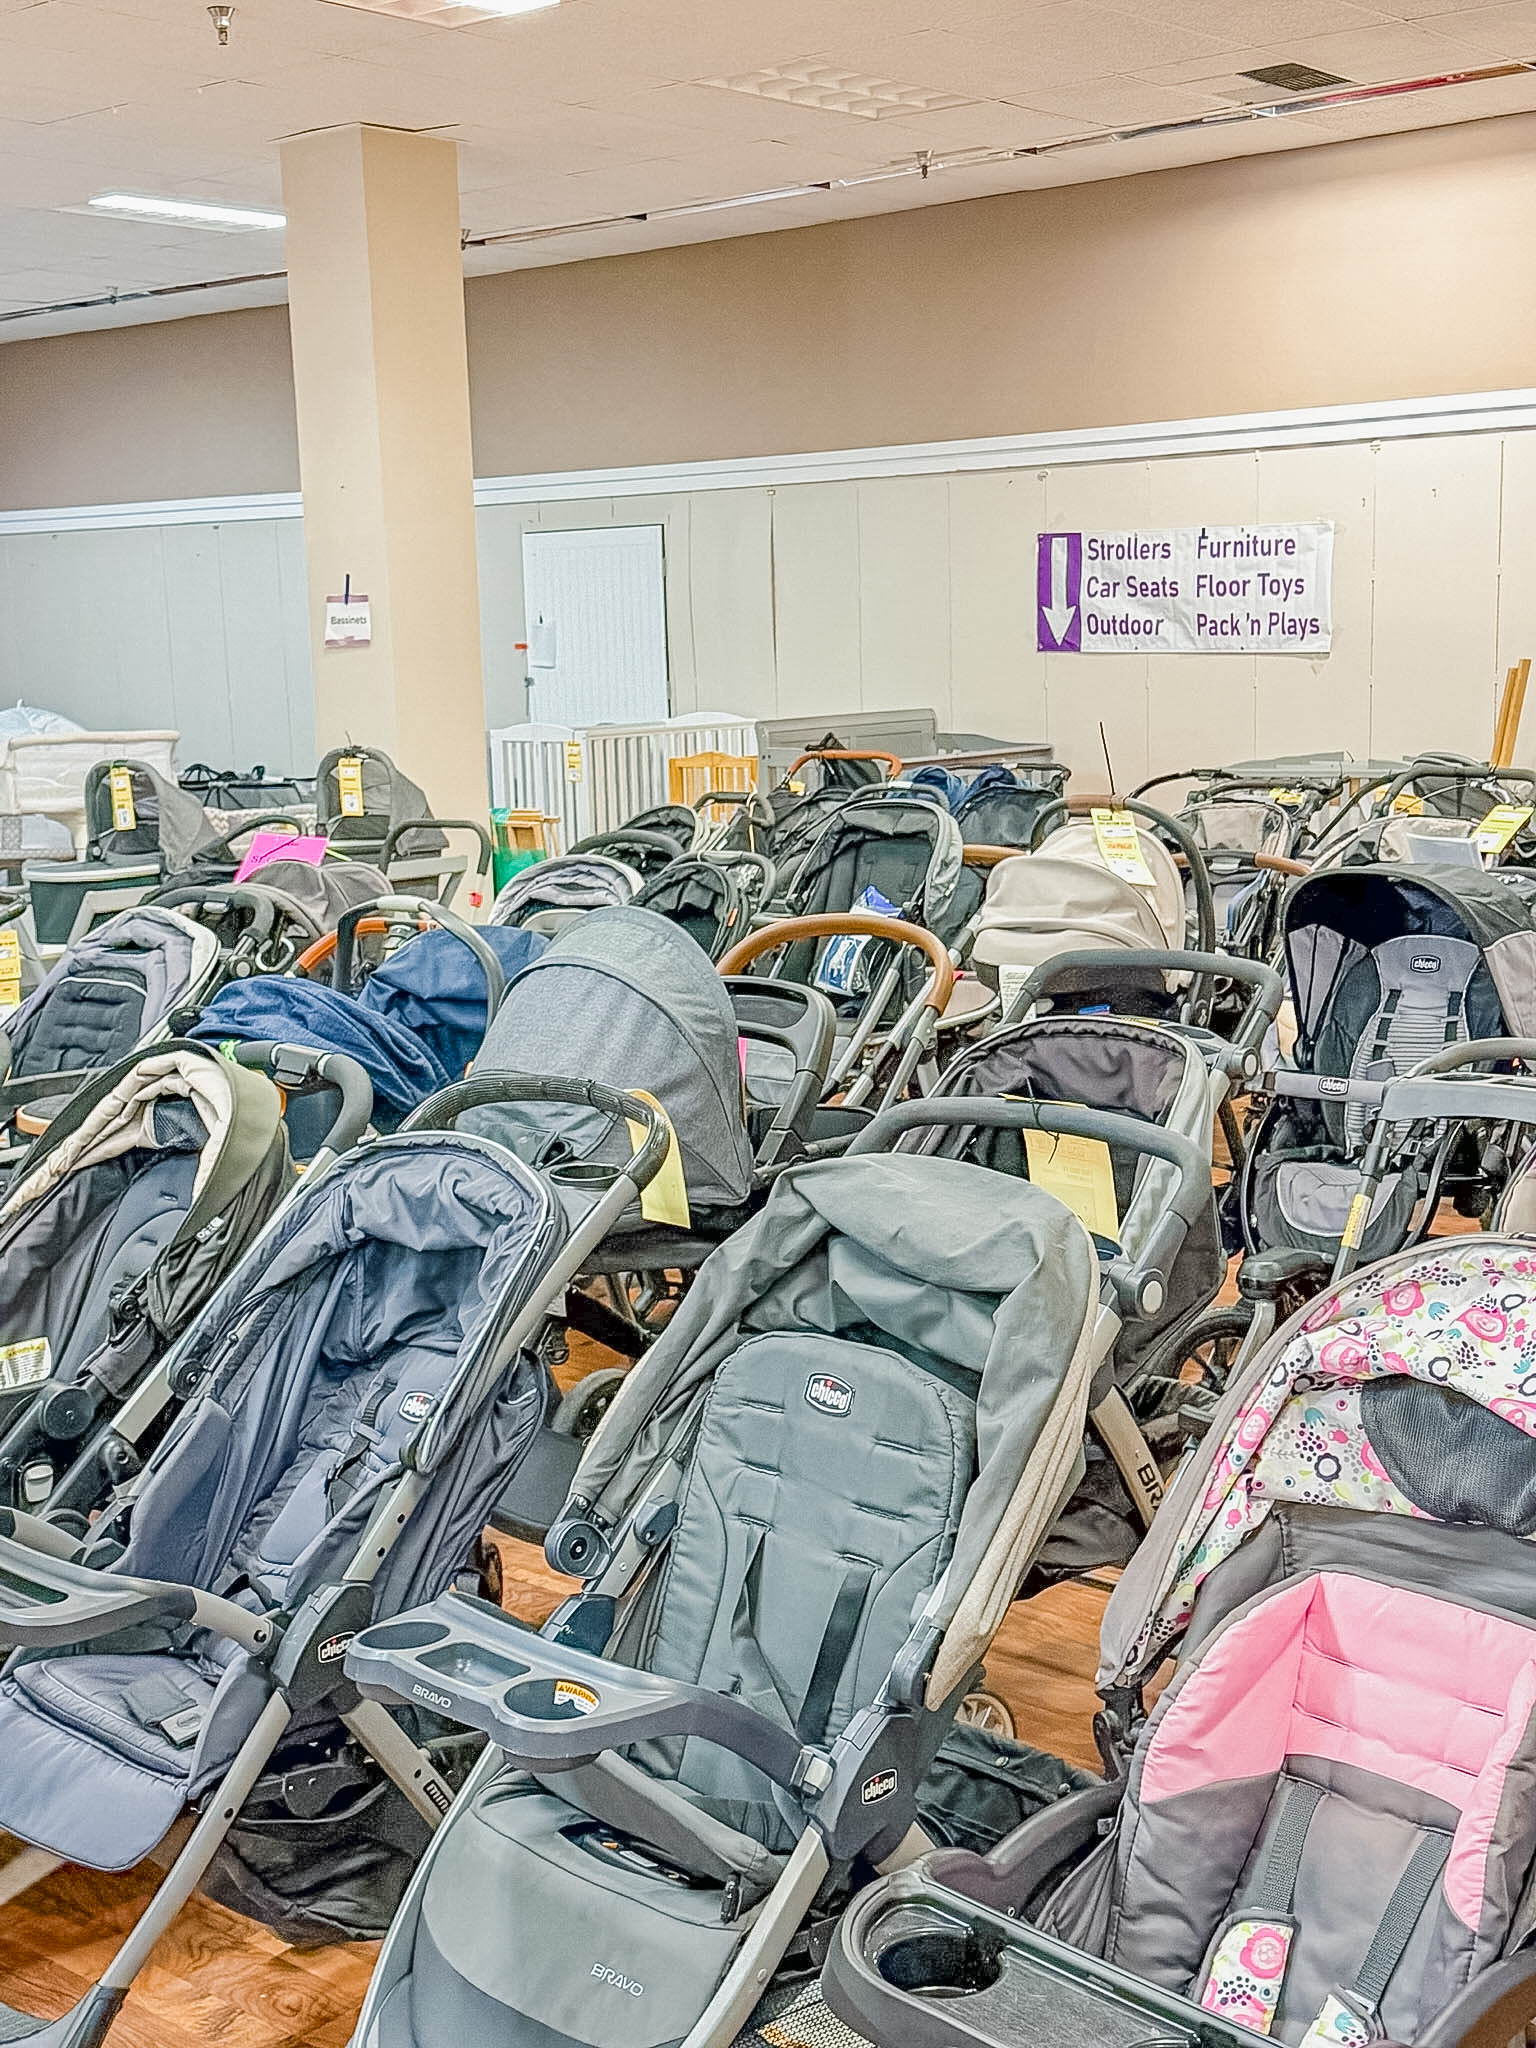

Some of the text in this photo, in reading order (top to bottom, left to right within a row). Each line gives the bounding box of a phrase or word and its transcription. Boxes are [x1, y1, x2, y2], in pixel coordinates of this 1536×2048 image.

[1087, 537, 1171, 561] Strollers
[1197, 533, 1297, 559] Furniture
[1087, 576, 1179, 598] Car Seats
[1197, 573, 1305, 602] Floor Toys
[1087, 613, 1164, 636] Outdoor
[1197, 613, 1240, 637] Pack
[1268, 612, 1320, 641] Plays
[810, 1379, 849, 1409] chicco
[1137, 1463, 1163, 1511] BR
[321, 1638, 351, 1659] chicc
[412, 1684, 452, 1709] BRAVO
[864, 1776, 895, 1801] chicco
[590, 1963, 644, 1996] BRAVO
